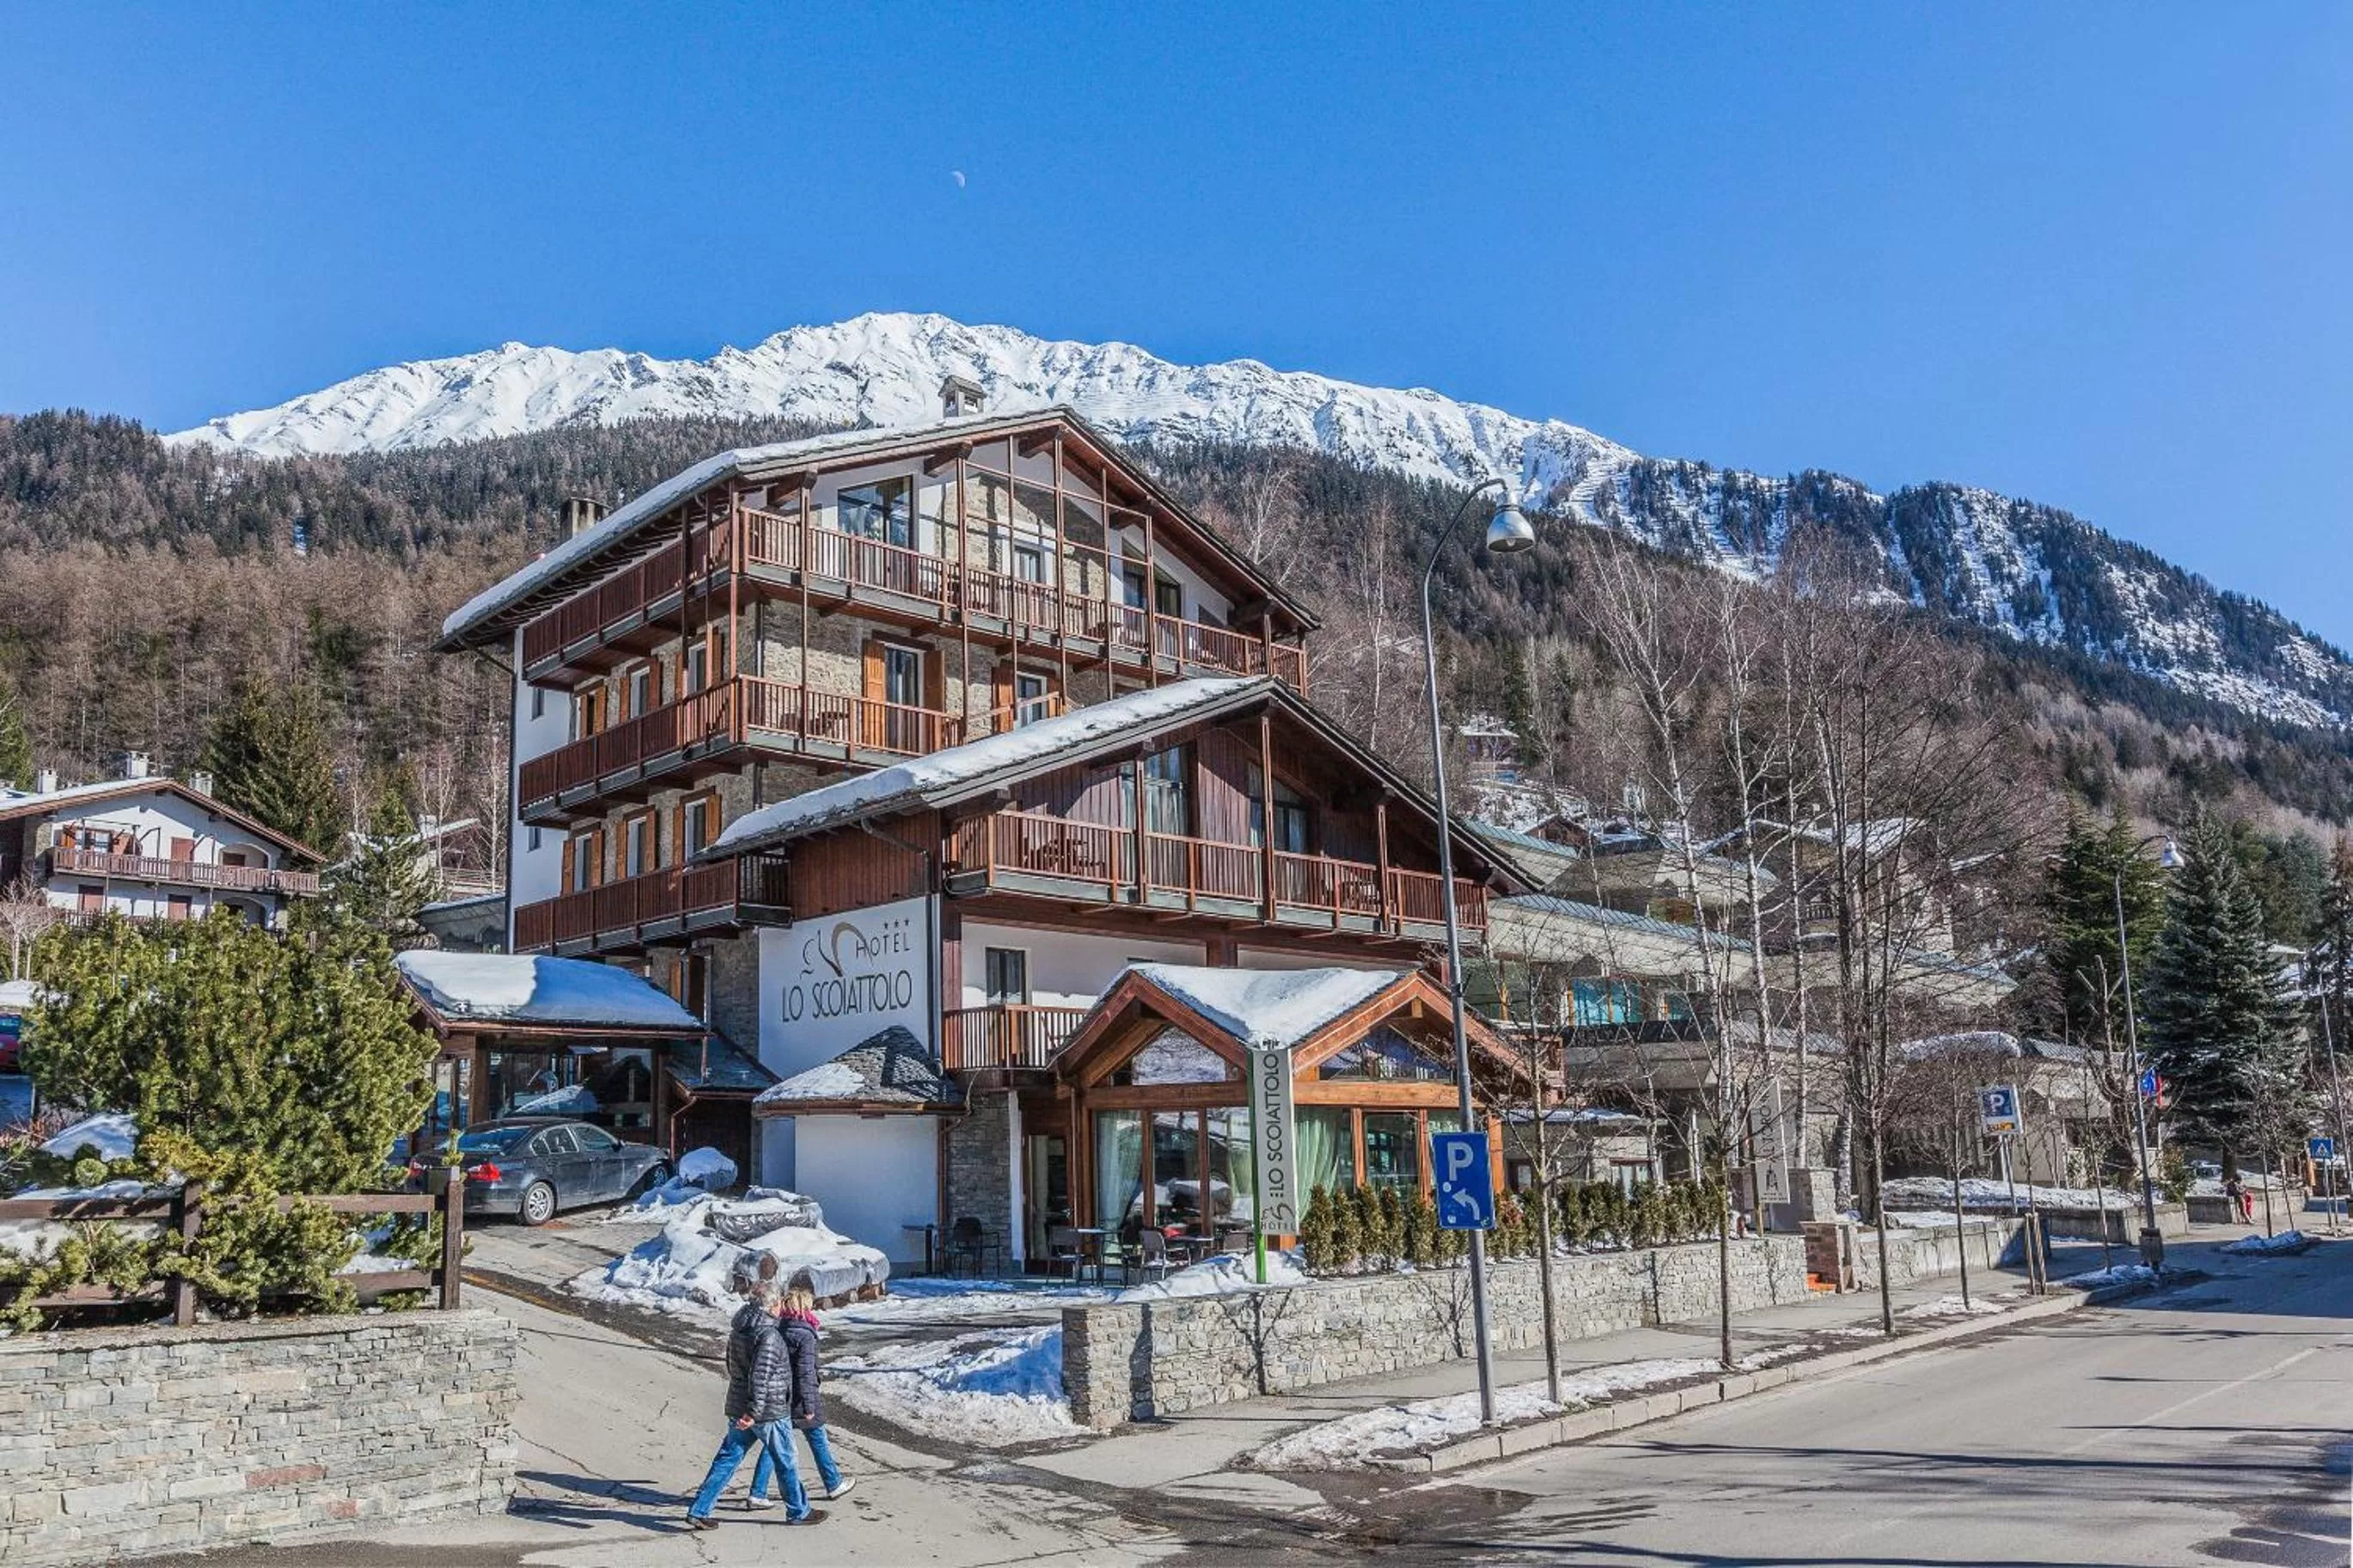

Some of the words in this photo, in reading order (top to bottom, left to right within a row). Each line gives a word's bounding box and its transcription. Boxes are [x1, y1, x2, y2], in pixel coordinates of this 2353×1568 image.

[856, 932, 911, 958] HOTEL
[782, 985, 804, 1022] LO
[811, 969, 913, 1018] SCOIATTOLO
[1262, 1053, 1283, 1162] SCOIATTOLO
[1989, 1094, 2005, 1113] P
[1447, 1141, 1474, 1181] P
[1268, 1168, 1284, 1193] LO
